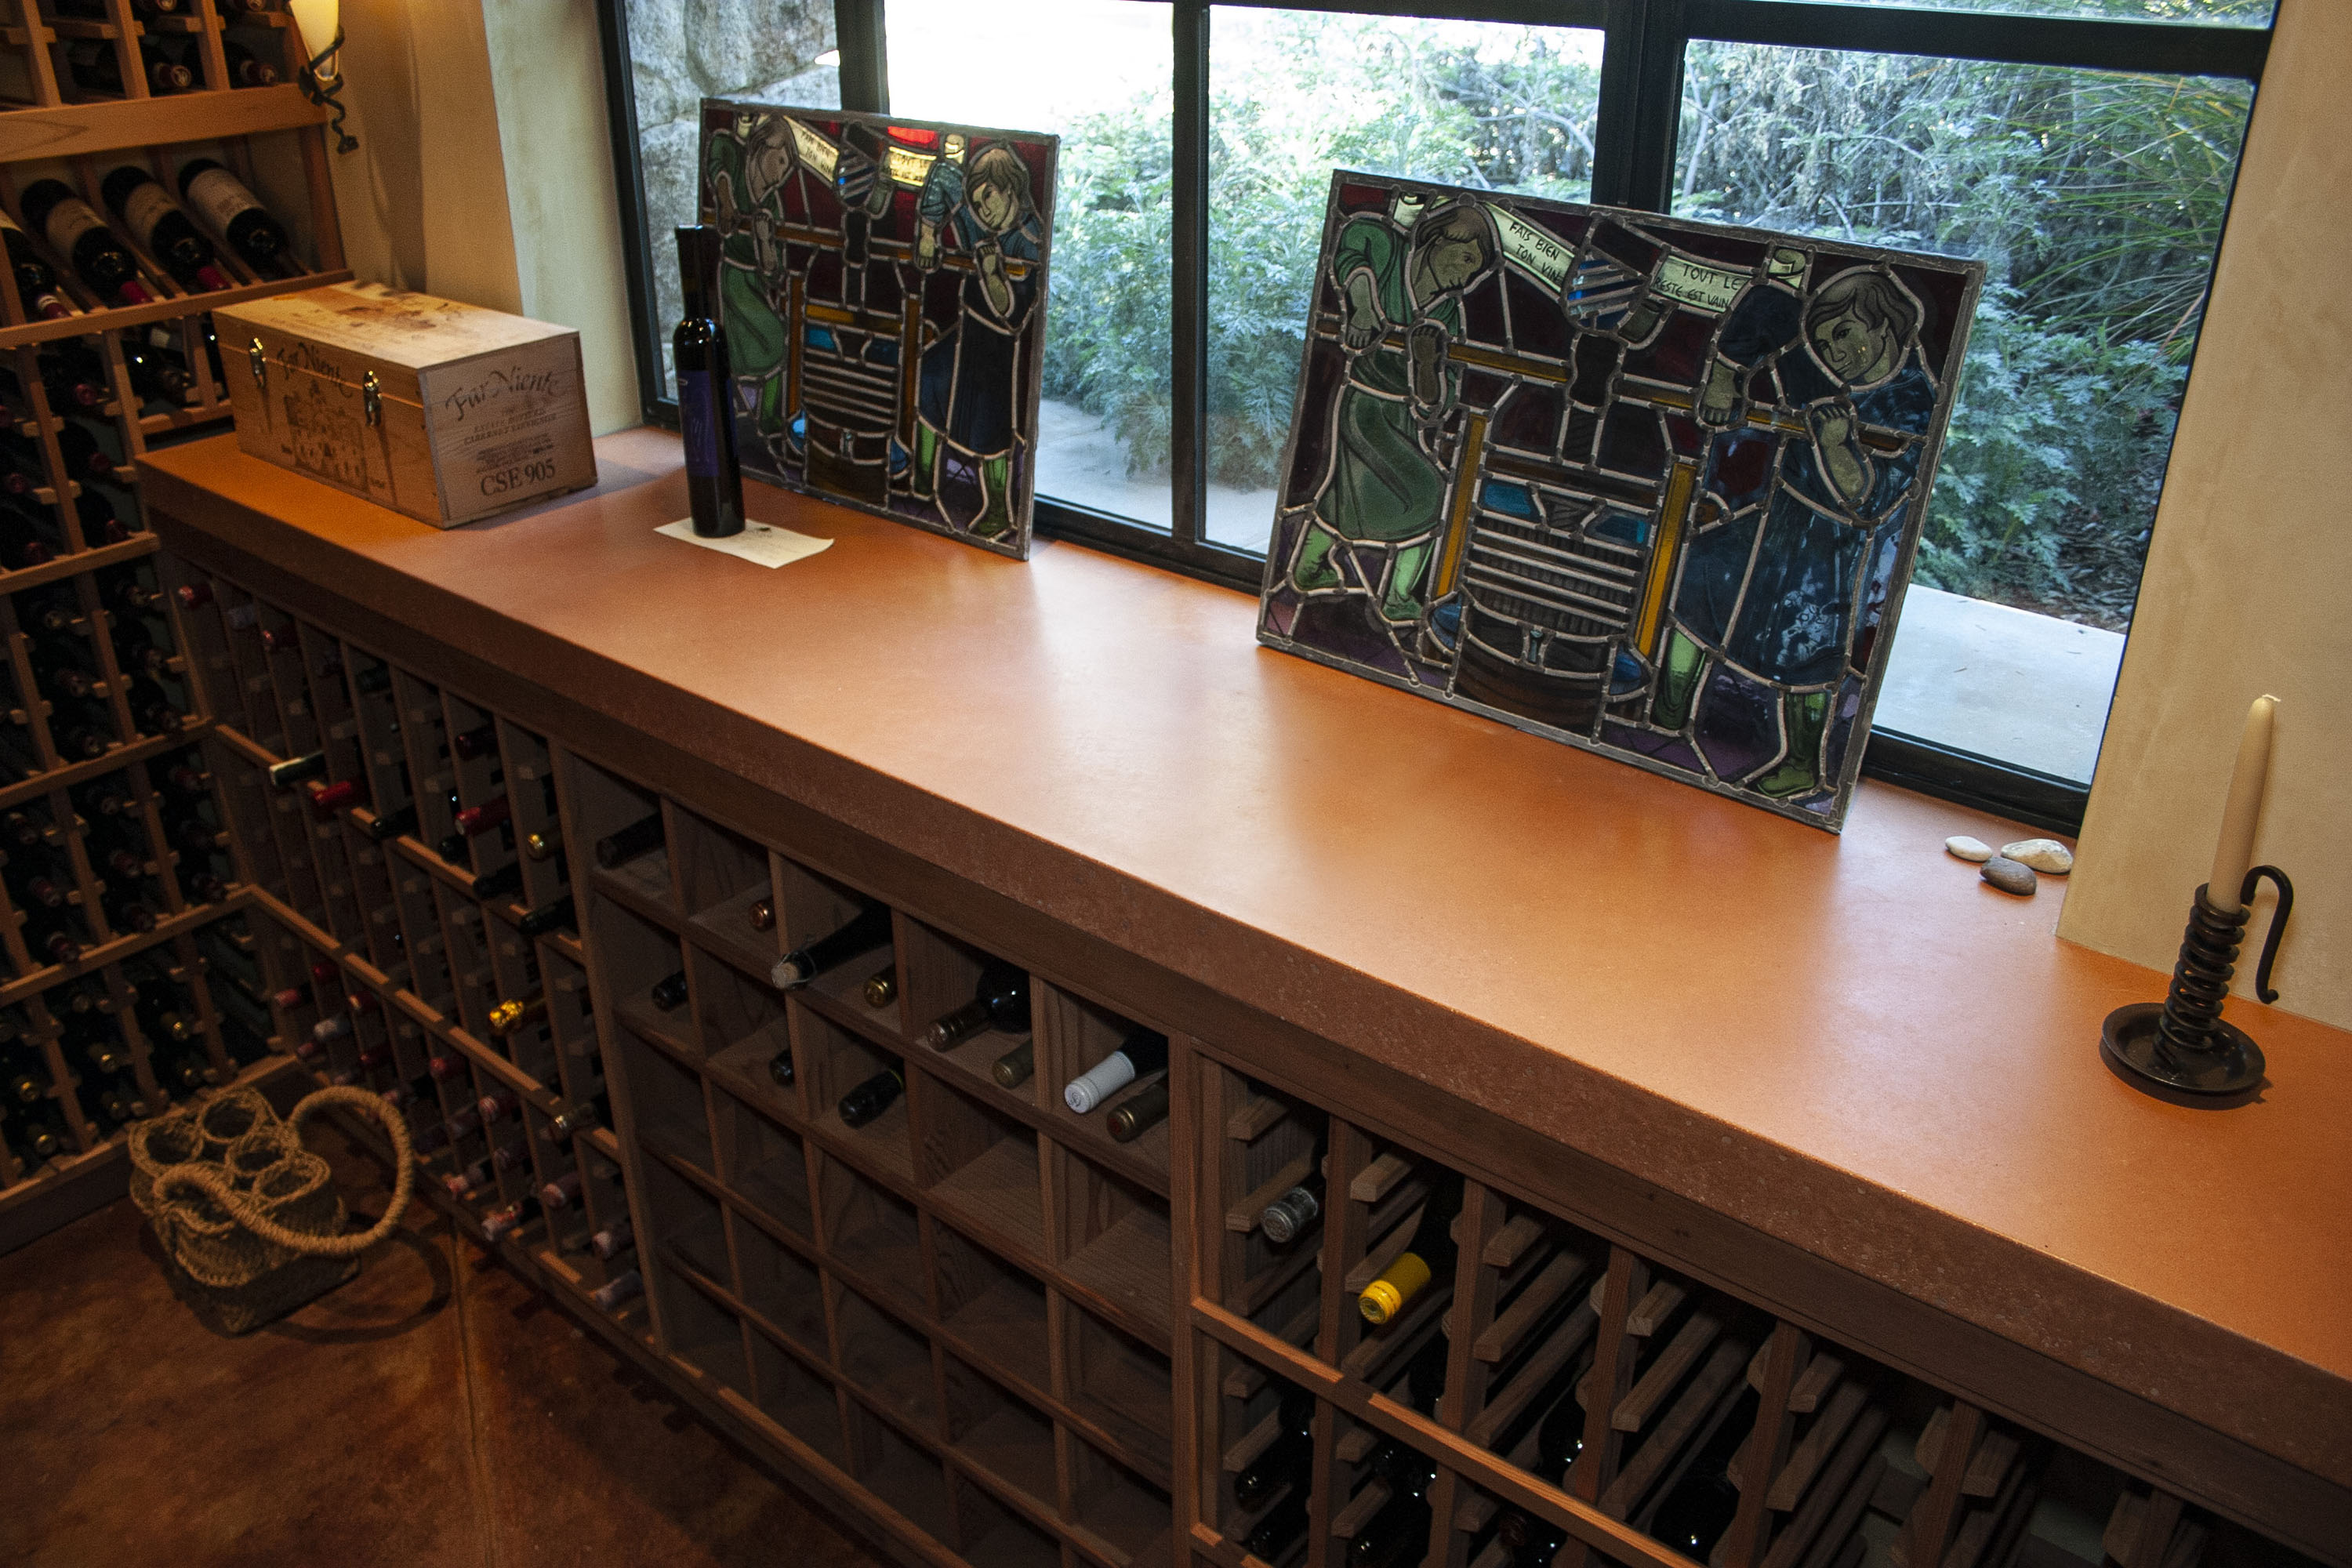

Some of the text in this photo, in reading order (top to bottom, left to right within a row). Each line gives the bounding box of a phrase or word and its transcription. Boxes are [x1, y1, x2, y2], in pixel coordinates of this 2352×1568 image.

[1509, 221, 1560, 261] FAIS BIEN
[1515, 244, 1561, 281] TON VIN
[1682, 263, 1740, 290] TOUT LE
[1655, 277, 1729, 307] RESTE EST VAIN
[445, 381, 489, 422] Far
[481, 458, 556, 496] CSE 905
